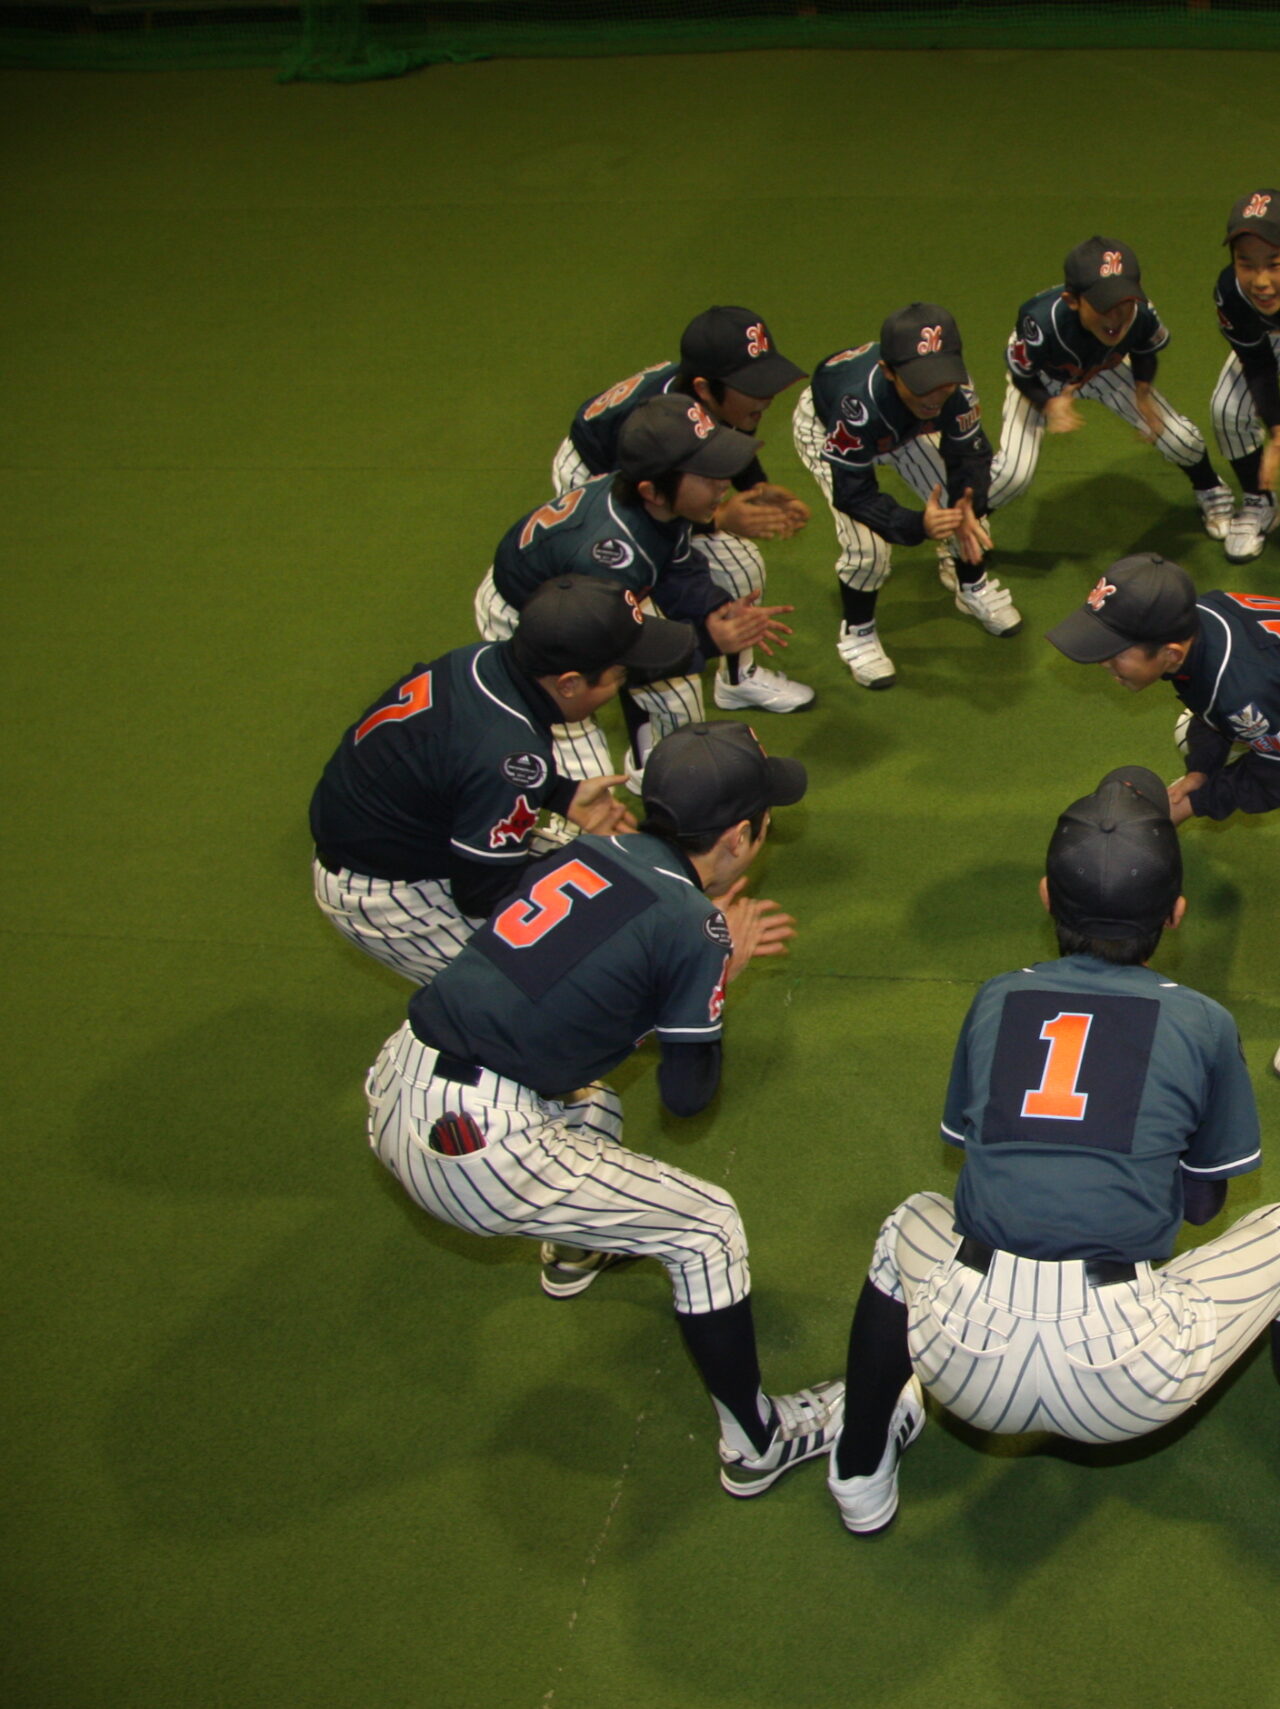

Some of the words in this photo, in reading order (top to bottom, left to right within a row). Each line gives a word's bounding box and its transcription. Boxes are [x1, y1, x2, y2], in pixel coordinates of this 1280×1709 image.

[352, 670, 433, 743] 7
[492, 858, 612, 949] 5
[1020, 1012, 1094, 1121] 1
